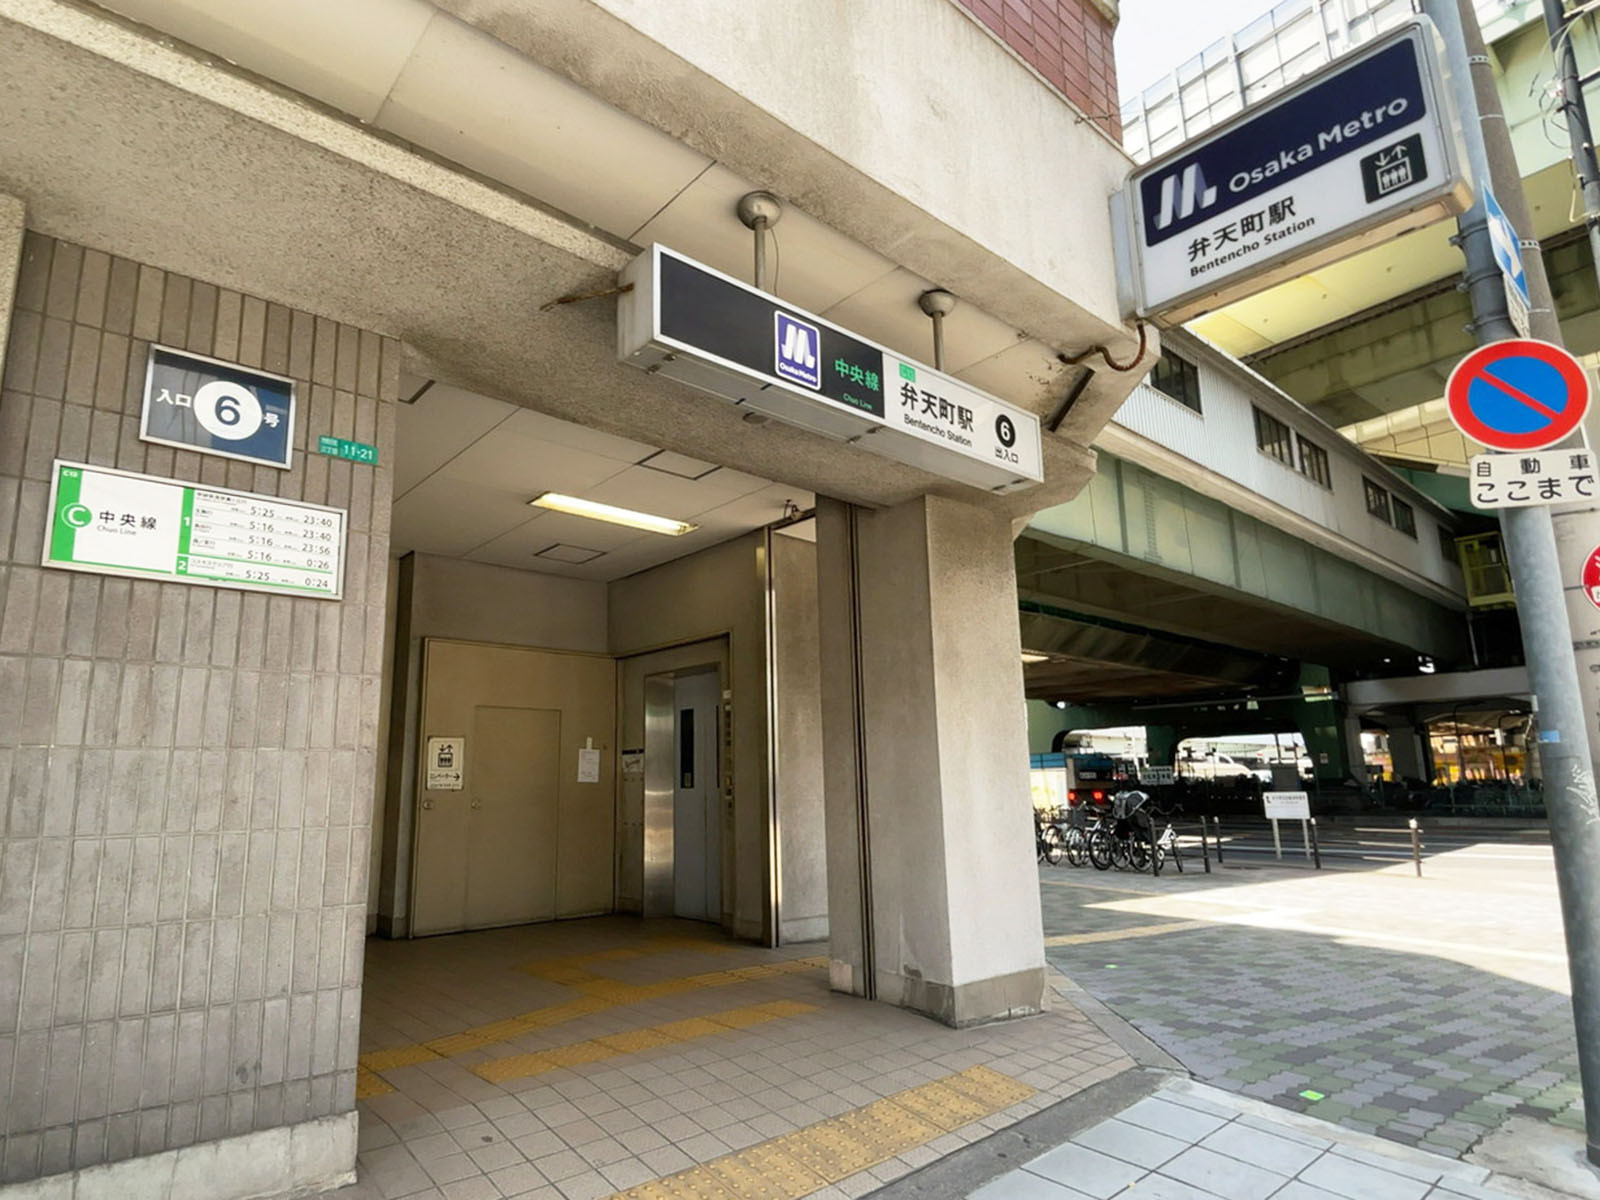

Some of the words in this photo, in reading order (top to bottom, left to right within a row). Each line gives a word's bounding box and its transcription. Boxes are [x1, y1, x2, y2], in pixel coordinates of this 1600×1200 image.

[1228, 145, 1313, 194] Osaka
[1316, 97, 1408, 151] Metro
[1187, 196, 1296, 262] 弁天町駅
[1190, 240, 1261, 277] Bentencho
[1263, 216, 1316, 246] Station
[779, 362, 799, 377] Osaka
[834, 358, 880, 392] 中央線
[156, 388, 192, 407] 入口
[900, 382, 974, 433] 弁天町駅
[214, 395, 241, 427] 6
[263, 412, 280, 428] 号
[904, 413, 946, 437] Bentencho
[947, 430, 973, 448] Station
[1000, 423, 1011, 440] 6
[343, 444, 373, 460] 11-21
[995, 446, 1019, 464] 出入口
[1476, 454, 1590, 477] 自動車
[1477, 475, 1595, 503] ここまで
[68, 507, 86, 526] C
[99, 509, 157, 530] 中央線
[183, 516, 190, 527] 1
[250, 506, 275, 519] 5:25
[303, 514, 332, 527] 23:40
[119, 526, 137, 536] Line
[249, 521, 274, 533] 5:16
[302, 529, 332, 542] 23:40
[248, 535, 273, 547] 5:16
[301, 543, 331, 555] 23:56
[177, 560, 186, 570] 2
[247, 550, 272, 562] 5:16
[306, 558, 330, 570] 0:26
[245, 570, 270, 581] 5:25
[304, 577, 328, 588] 0:24
